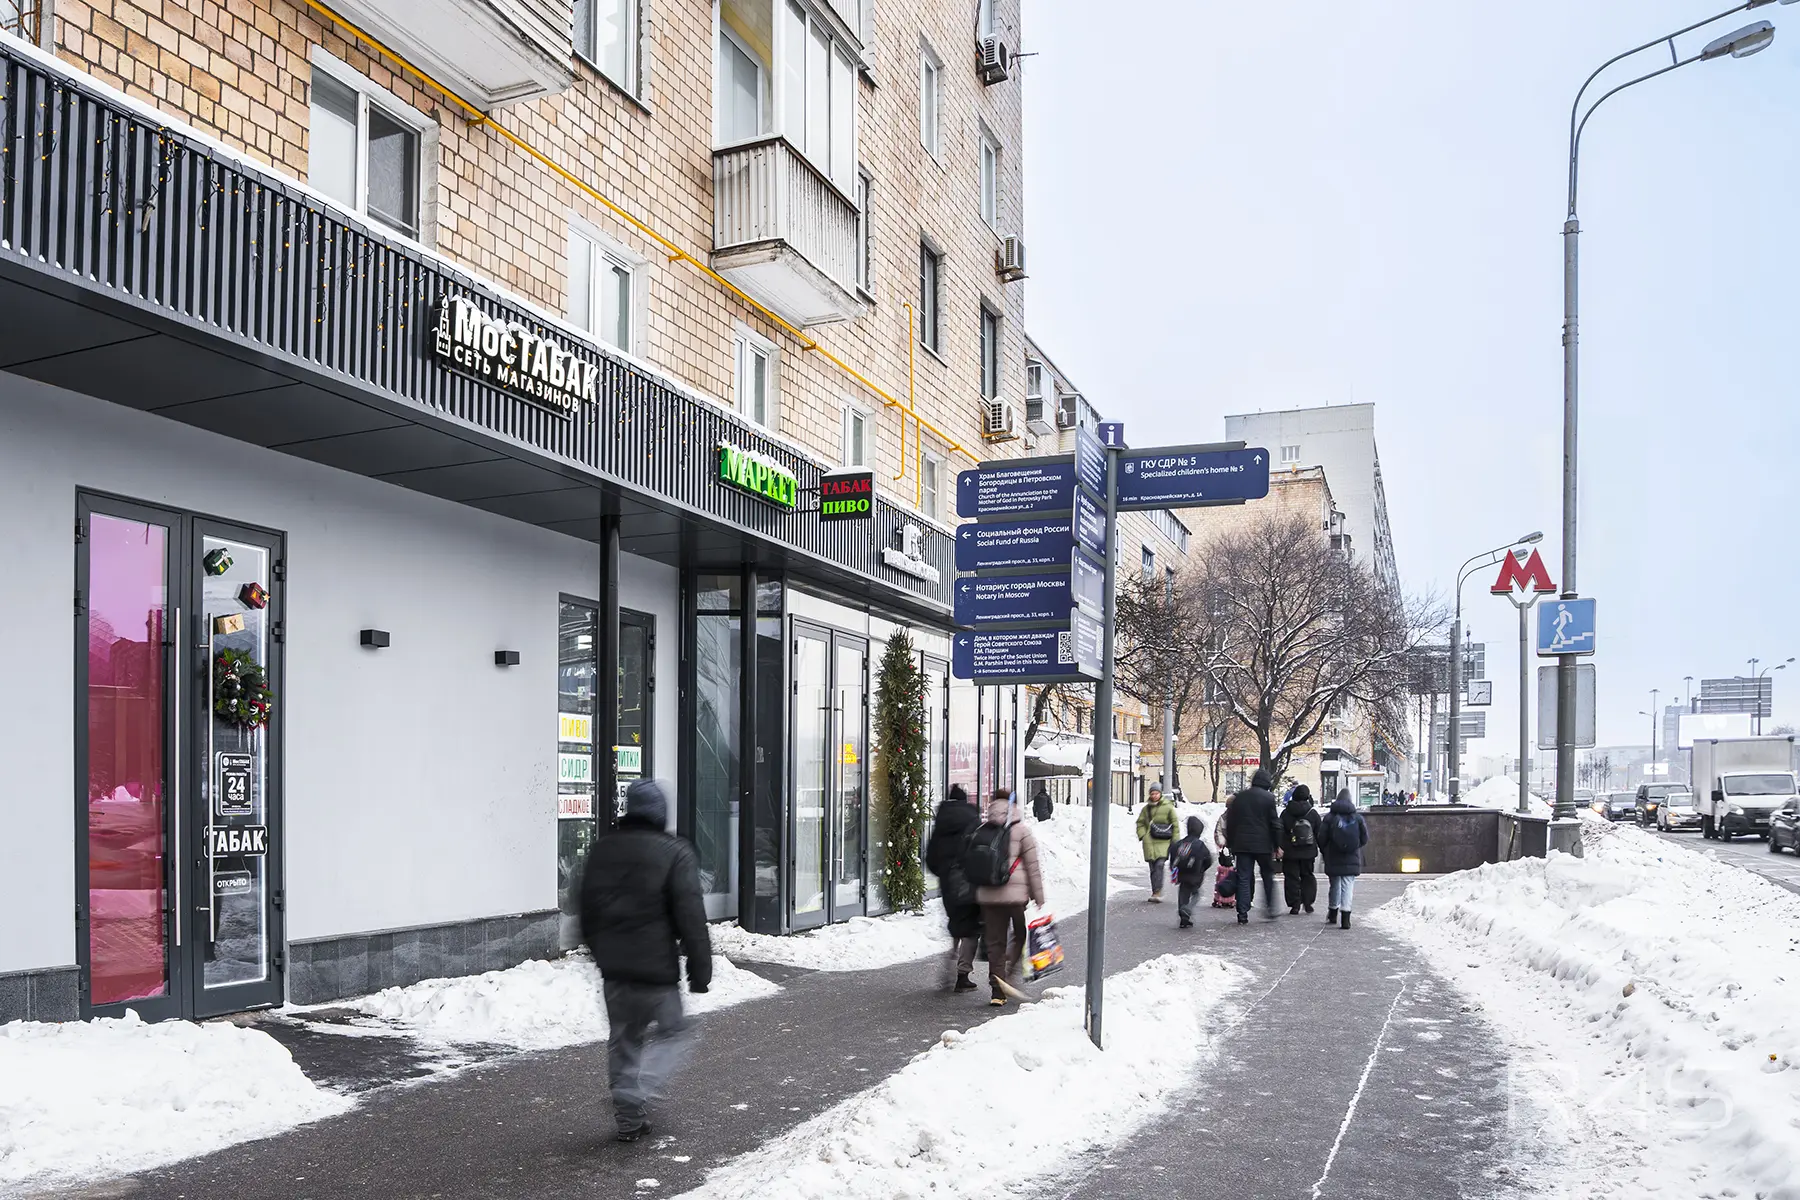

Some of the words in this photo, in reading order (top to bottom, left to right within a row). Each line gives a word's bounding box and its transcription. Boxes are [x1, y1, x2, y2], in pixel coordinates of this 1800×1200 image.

[454, 345, 491, 375] СЕТЬ
[497, 364, 580, 413] МАГАЗИНОВ
[1140, 459, 1157, 469] ГКУ
[1157, 458, 1177, 468] СДР
[1177, 457, 1188, 467] №
[1190, 456, 1197, 466] 5
[726, 446, 799, 508] МАРКЕТ
[996, 469, 1042, 478] Благовещения
[1140, 468, 1177, 479] Specialized
[1177, 466, 1209, 476] children's
[1210, 465, 1229, 474] home
[1239, 464, 1244, 472] 5
[820, 478, 872, 495] ТАБАК
[978, 478, 1018, 487] Богородицы
[1023, 475, 1062, 483] Петровском
[978, 486, 998, 494] парке
[822, 498, 870, 515] ПИВО
[976, 528, 1022, 538] Социальный
[1022, 527, 1043, 536] фонд
[1043, 525, 1070, 533] России
[976, 539, 995, 547] Social
[1019, 536, 1040, 544] Russia
[975, 582, 1009, 592] Нотариус
[1010, 581, 1036, 591] города
[1036, 580, 1066, 588] Москвы
[975, 593, 997, 601] Notary
[1004, 591, 1030, 599] Moscow
[984, 647, 1009, 655] Паршин
[561, 717, 588, 739] ПИВО
[561, 758, 588, 780] СИДР
[228, 776, 245, 794] 24
[216, 878, 247, 888] ОТКРЫТО
